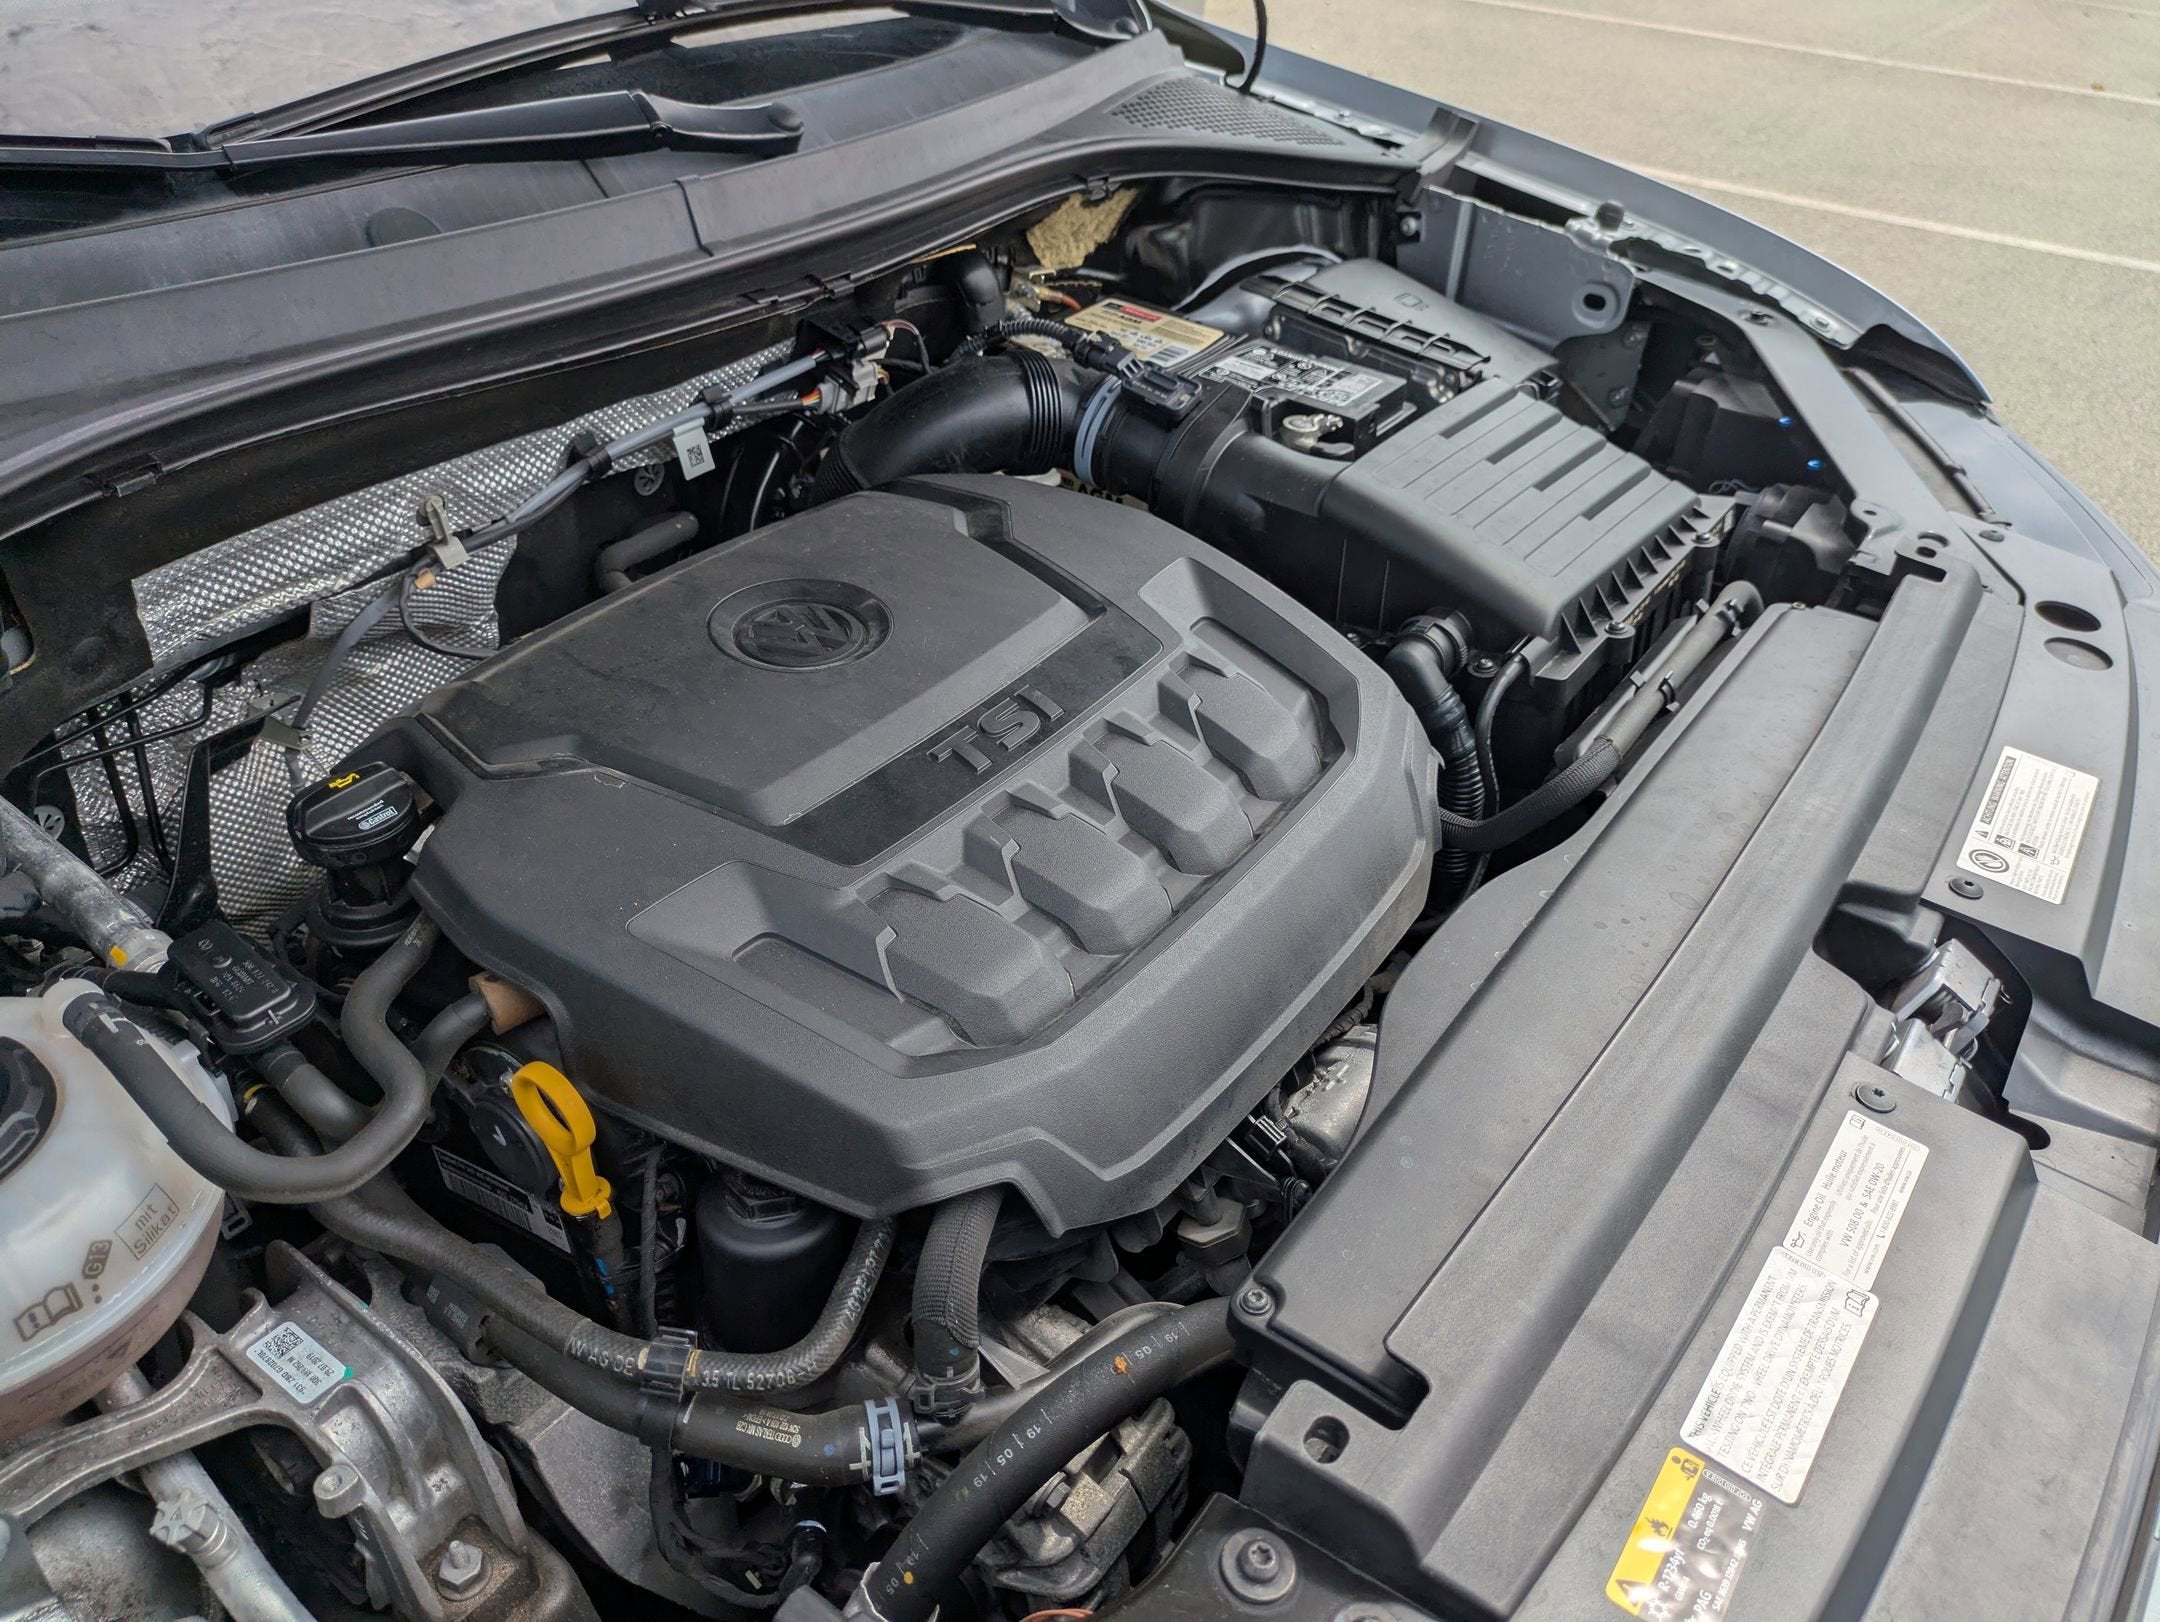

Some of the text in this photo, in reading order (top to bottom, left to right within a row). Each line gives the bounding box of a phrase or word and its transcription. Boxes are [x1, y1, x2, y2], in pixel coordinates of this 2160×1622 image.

[927, 685, 1065, 774] TSI
[368, 807, 394, 825] Castrol
[1820, 1148, 1848, 1190] Huile moteur
[135, 1202, 158, 1231] mit
[1802, 1191, 1827, 1228] Engine Oil
[1839, 1161, 1885, 1248] VW 508 00 & SAE 0W-20
[134, 1205, 177, 1254] Silikat
[1824, 1228, 1834, 1241] with
[85, 1242, 109, 1276] G13
[1862, 1242, 1881, 1274] www.vw.com
[1806, 1277, 1837, 1329] TRANSMISSION
[1133, 1329, 1179, 1360] 19 05
[1801, 1325, 1815, 1339] DE
[587, 1346, 611, 1368] AG
[611, 1352, 637, 1376] DE
[1687, 1273, 1778, 1442] THIS VEHICLE IS EQUIPPED WITH A PERMANENT
[1724, 1380, 1742, 1406] DRIVE
[1735, 1351, 1757, 1383] SYSTEM
[1749, 1334, 1765, 1354] AND
[1757, 1326, 1769, 1337] IS
[726, 1371, 739, 1390] TL
[1716, 1421, 1741, 1461] TESTING
[1732, 1408, 1748, 1425] ON
[1761, 1338, 1781, 1364] DRIVE
[1763, 1407, 1778, 1424] EST
[1773, 1392, 1803, 1442] PERMANENT
[1794, 1382, 1807, 1396] ET
[1769, 1471, 1787, 1493] SUR
[1818, 1355, 1837, 1382] ROUES
[971, 1422, 1042, 1488] 19 05 19
[1740, 1459, 1754, 1475] CE
[1686, 1491, 1713, 1529] 0.460 kg
[1741, 1497, 1763, 1532] VW AG
[882, 1576, 901, 1595] 05
[1656, 1544, 1690, 1593] R-1234yf
[1691, 1588, 1713, 1615] PAG
[1710, 1595, 1724, 1611] SAE
